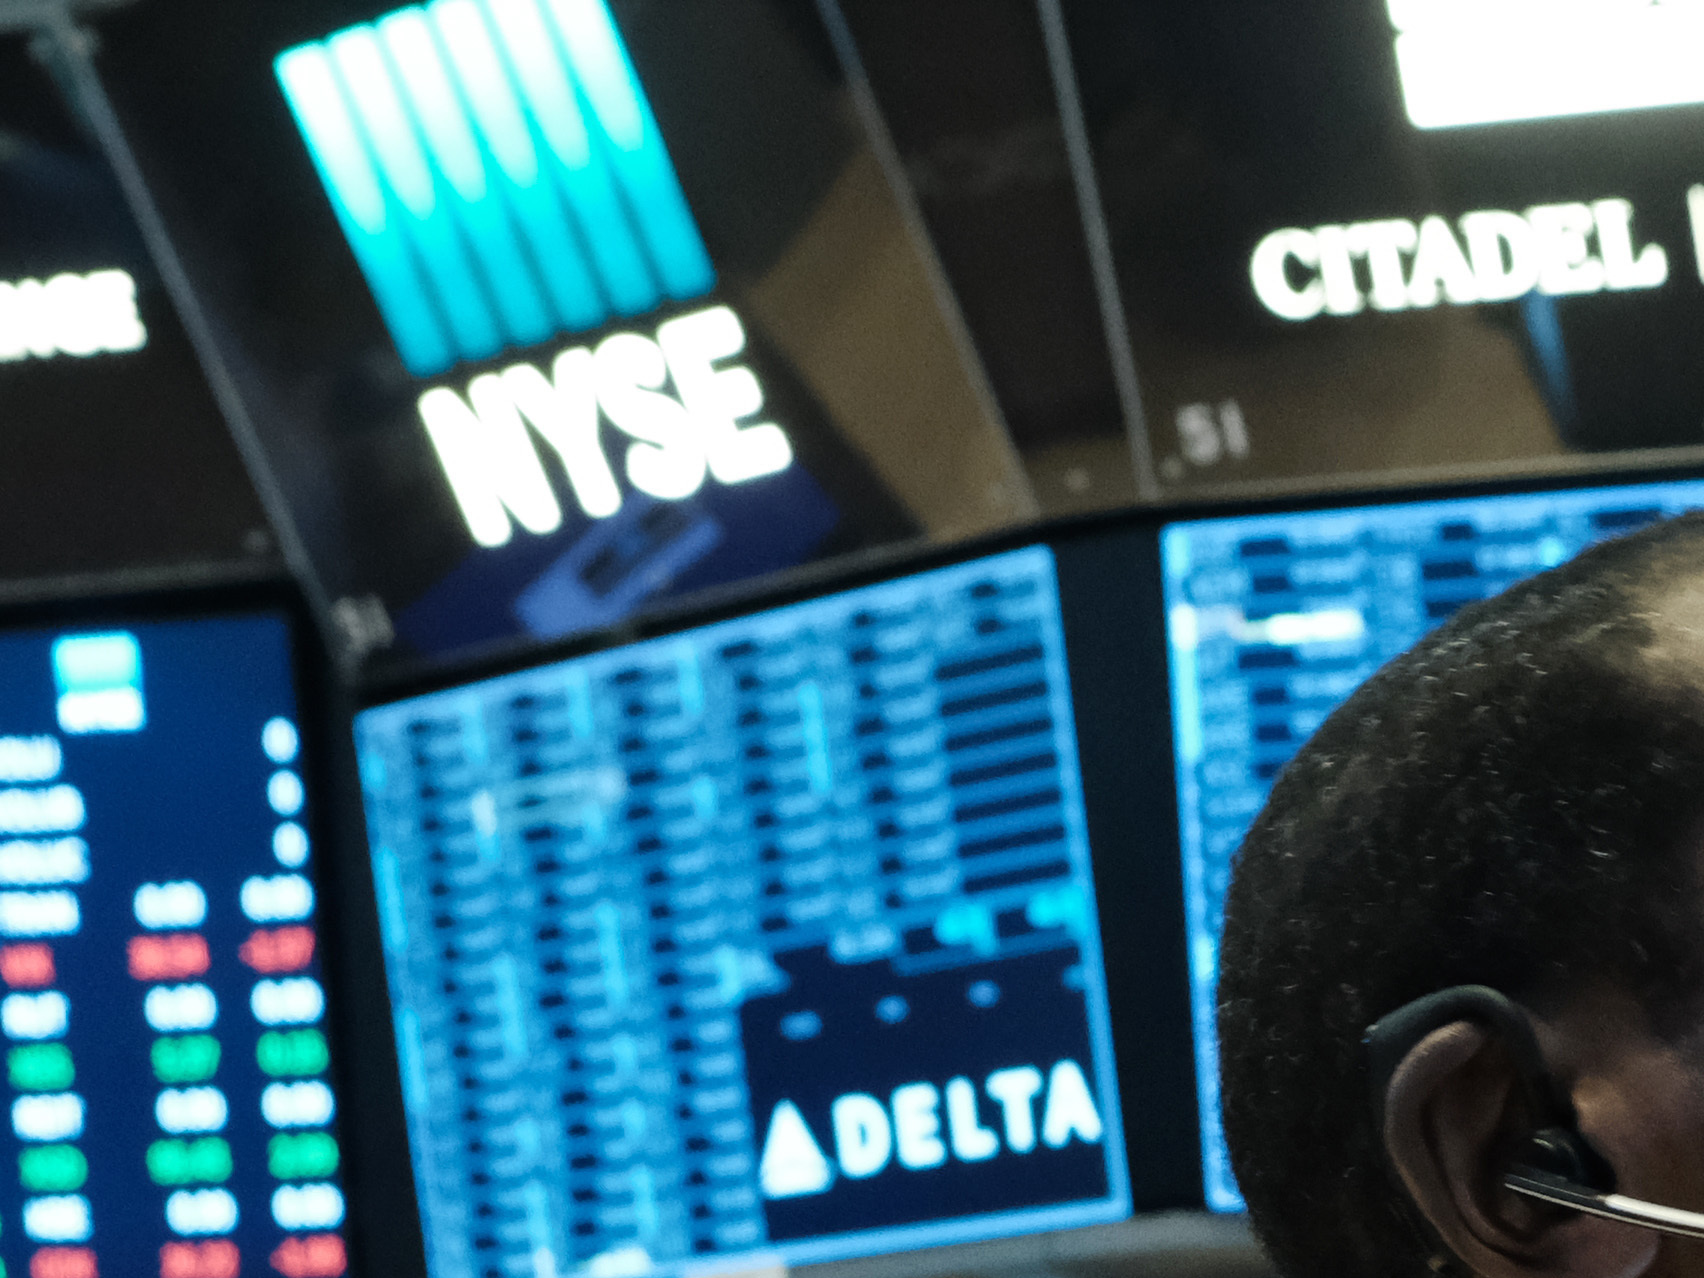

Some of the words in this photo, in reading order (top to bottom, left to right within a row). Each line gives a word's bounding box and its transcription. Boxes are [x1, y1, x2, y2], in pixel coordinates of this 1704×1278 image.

[1250, 199, 1667, 320] CITADEL
[417, 305, 796, 549] NYSE
[831, 1057, 1103, 1181] DELTA
